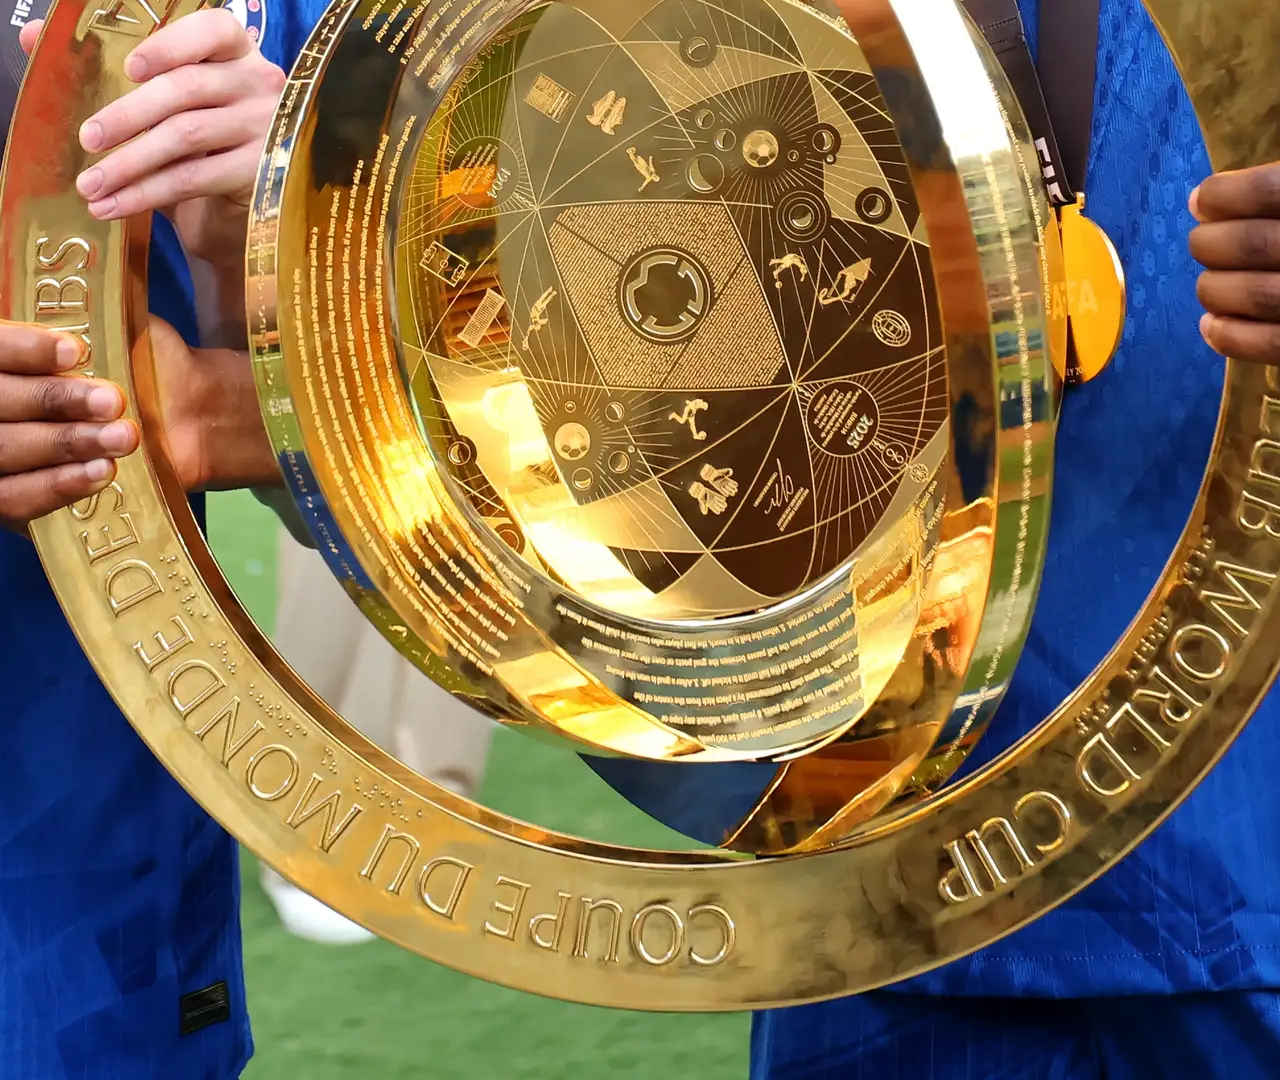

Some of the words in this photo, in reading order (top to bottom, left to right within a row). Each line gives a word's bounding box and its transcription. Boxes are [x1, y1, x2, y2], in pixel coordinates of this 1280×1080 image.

[360, 2, 384, 30] opposite
[401, 16, 415, 32] such
[411, 4, 424, 18] kick
[373, 21, 391, 42] player
[387, 44, 396, 53] to
[391, 30, 405, 45] take
[847, 413, 873, 448] 2025
[70, 480, 165, 618] DES
[1075, 560, 1277, 797] WORLD
[133, 614, 363, 854] MONDE
[937, 790, 1071, 904] CUP
[359, 823, 475, 921] DU
[484, 875, 736, 966] COUPE
